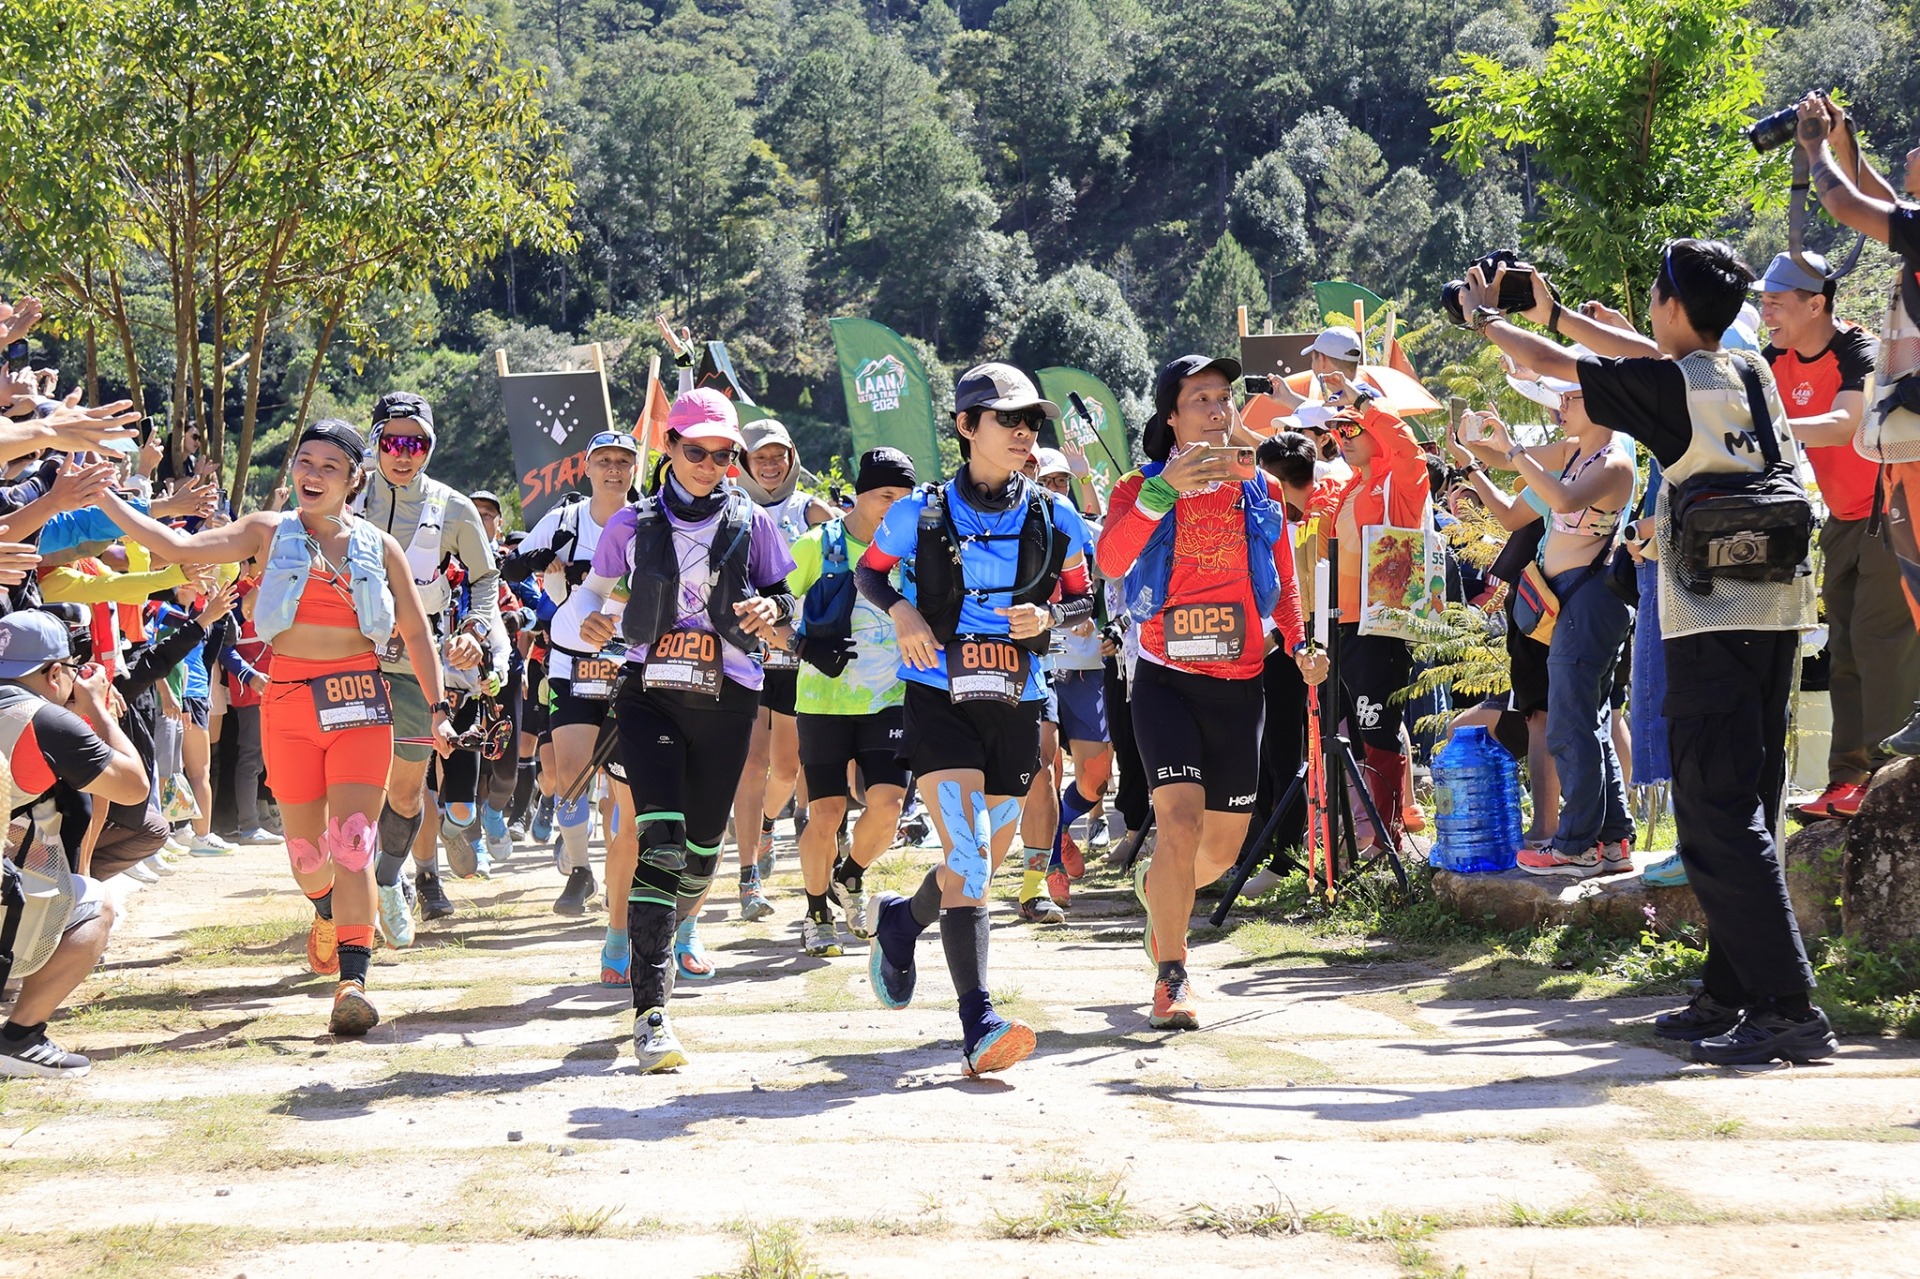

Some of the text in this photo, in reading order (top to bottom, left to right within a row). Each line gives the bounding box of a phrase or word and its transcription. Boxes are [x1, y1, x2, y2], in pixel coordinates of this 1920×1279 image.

[855, 374, 897, 395] LAAN
[857, 390, 899, 403] ULTRA TRAIL
[872, 397, 899, 412] 2024
[1077, 433, 1099, 446] 2024
[520, 450, 588, 509] STAR
[1432, 551, 1444, 566] 55
[1173, 606, 1235, 635] 8025
[655, 631, 715, 662] 8020
[962, 642, 1020, 673] 8010
[578, 660, 618, 680] 8023
[325, 674, 377, 703] 8019
[1157, 765, 1202, 780] ELITE
